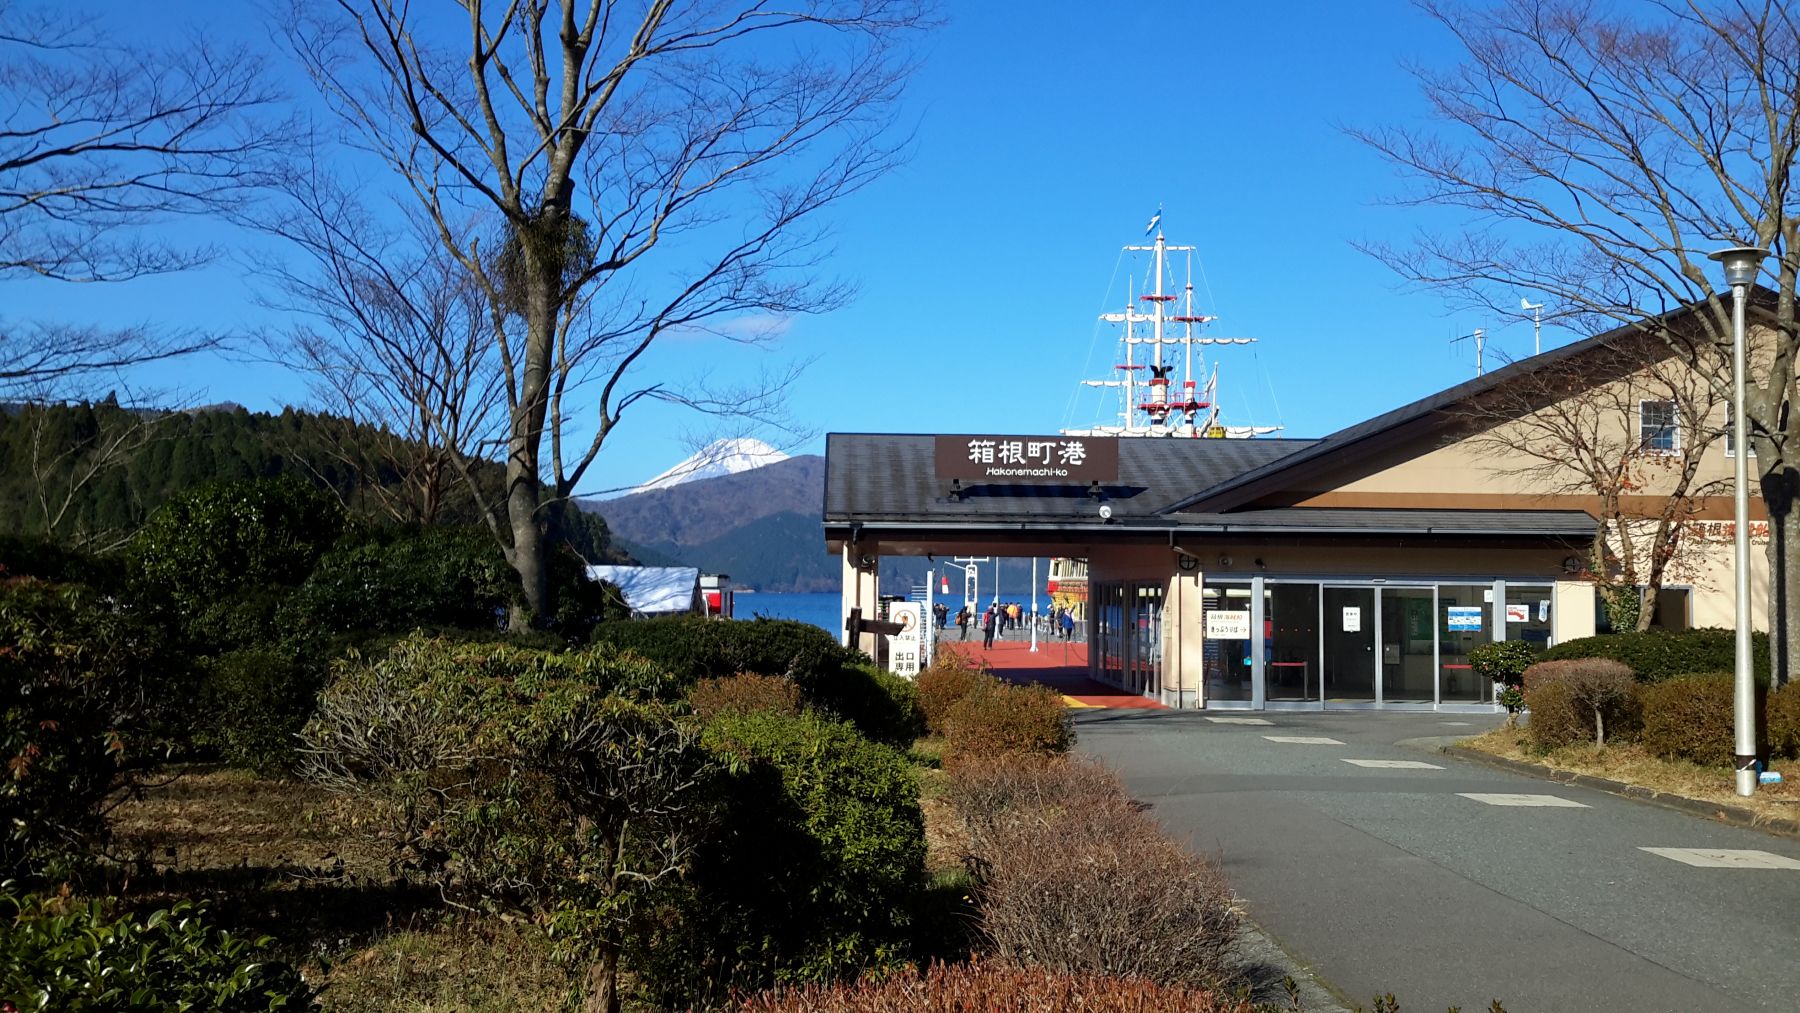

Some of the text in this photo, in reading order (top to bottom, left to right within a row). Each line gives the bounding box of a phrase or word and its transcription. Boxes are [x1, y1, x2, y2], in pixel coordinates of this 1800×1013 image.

[968, 439, 1087, 465] 箱根町港
[986, 467, 1068, 477] Hakonemachi-ko
[895, 652, 914, 661] 出口
[895, 662, 914, 671] 専用
